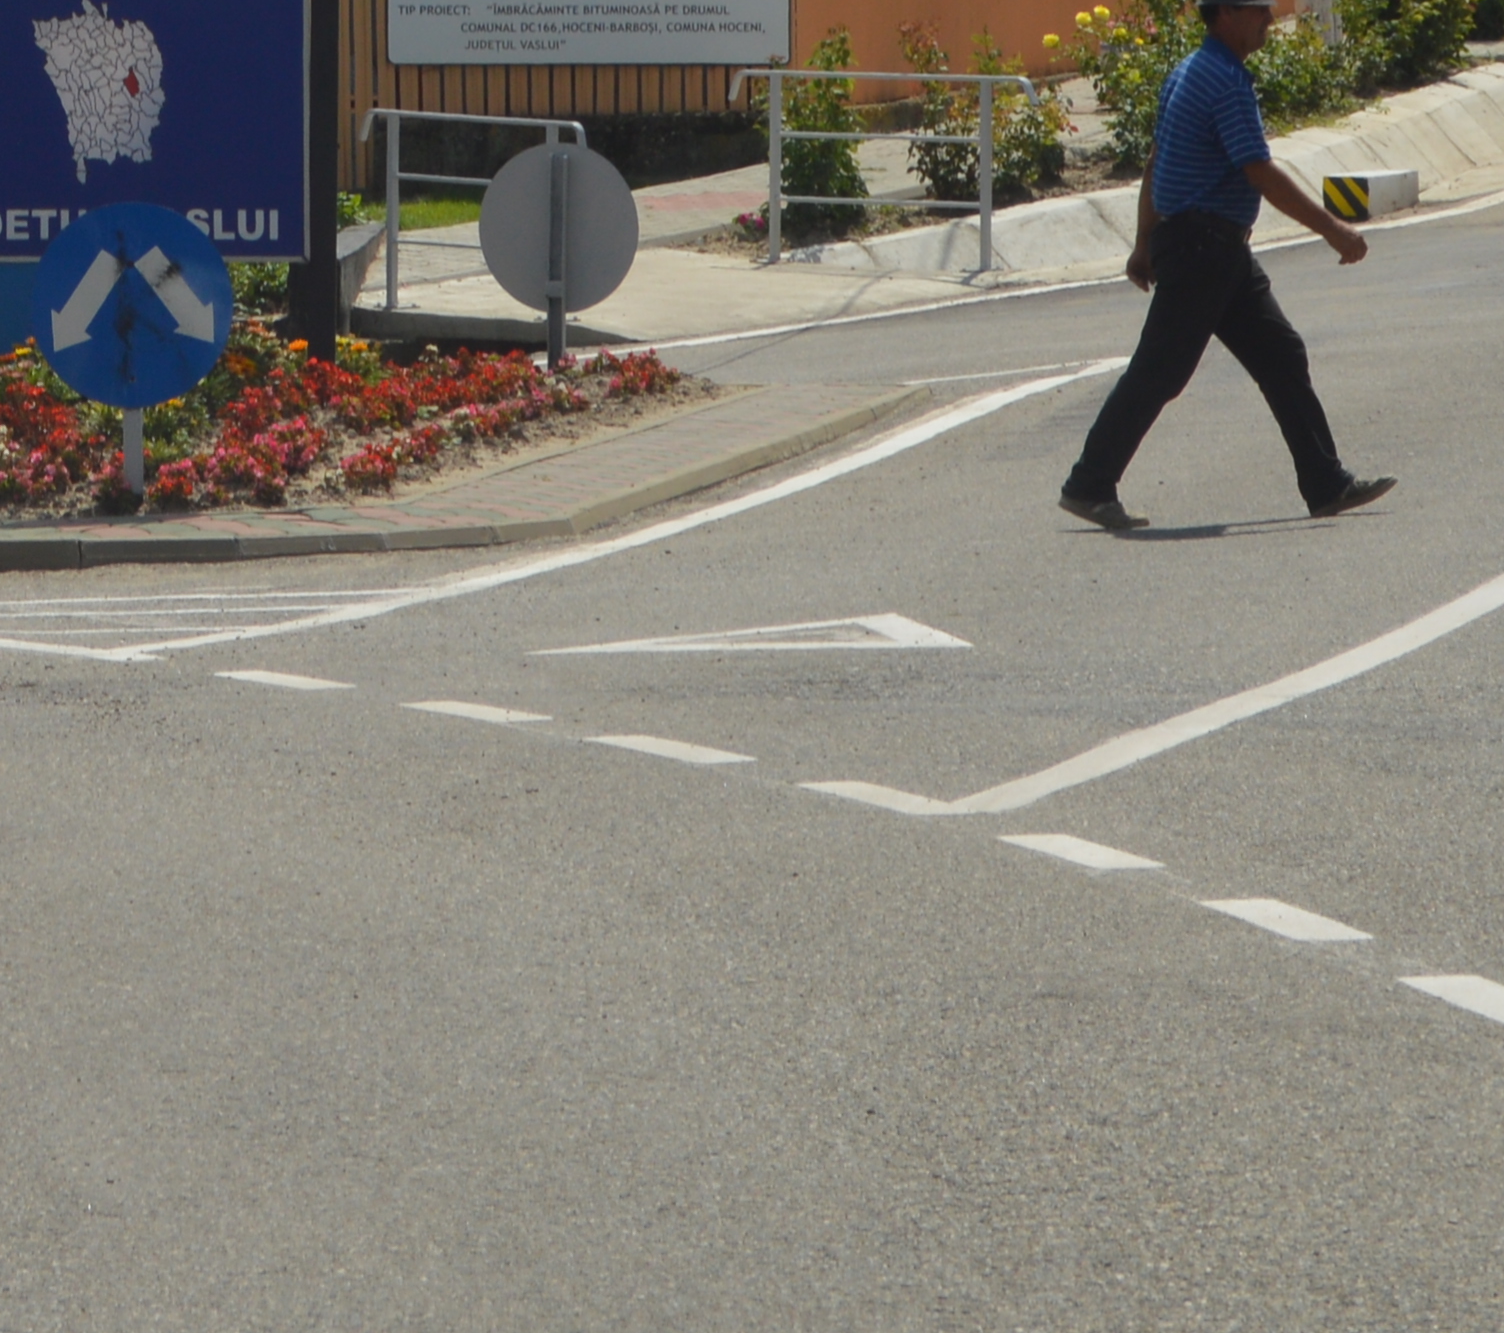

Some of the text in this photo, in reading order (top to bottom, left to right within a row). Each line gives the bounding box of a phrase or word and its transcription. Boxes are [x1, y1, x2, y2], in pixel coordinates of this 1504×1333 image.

[398, 5, 416, 15] TIP
[419, 5, 471, 15] PROIECT:
[583, 3, 660, 15] BITUMINOASĂ
[664, 5, 678, 15] PE
[682, 5, 730, 15] DRUMUL
[461, 22, 516, 33] COMUNAL
[666, 22, 715, 33] COMUNA
[719, 22, 766, 34] HOCENI,
[185, 209, 280, 241] SLUI
